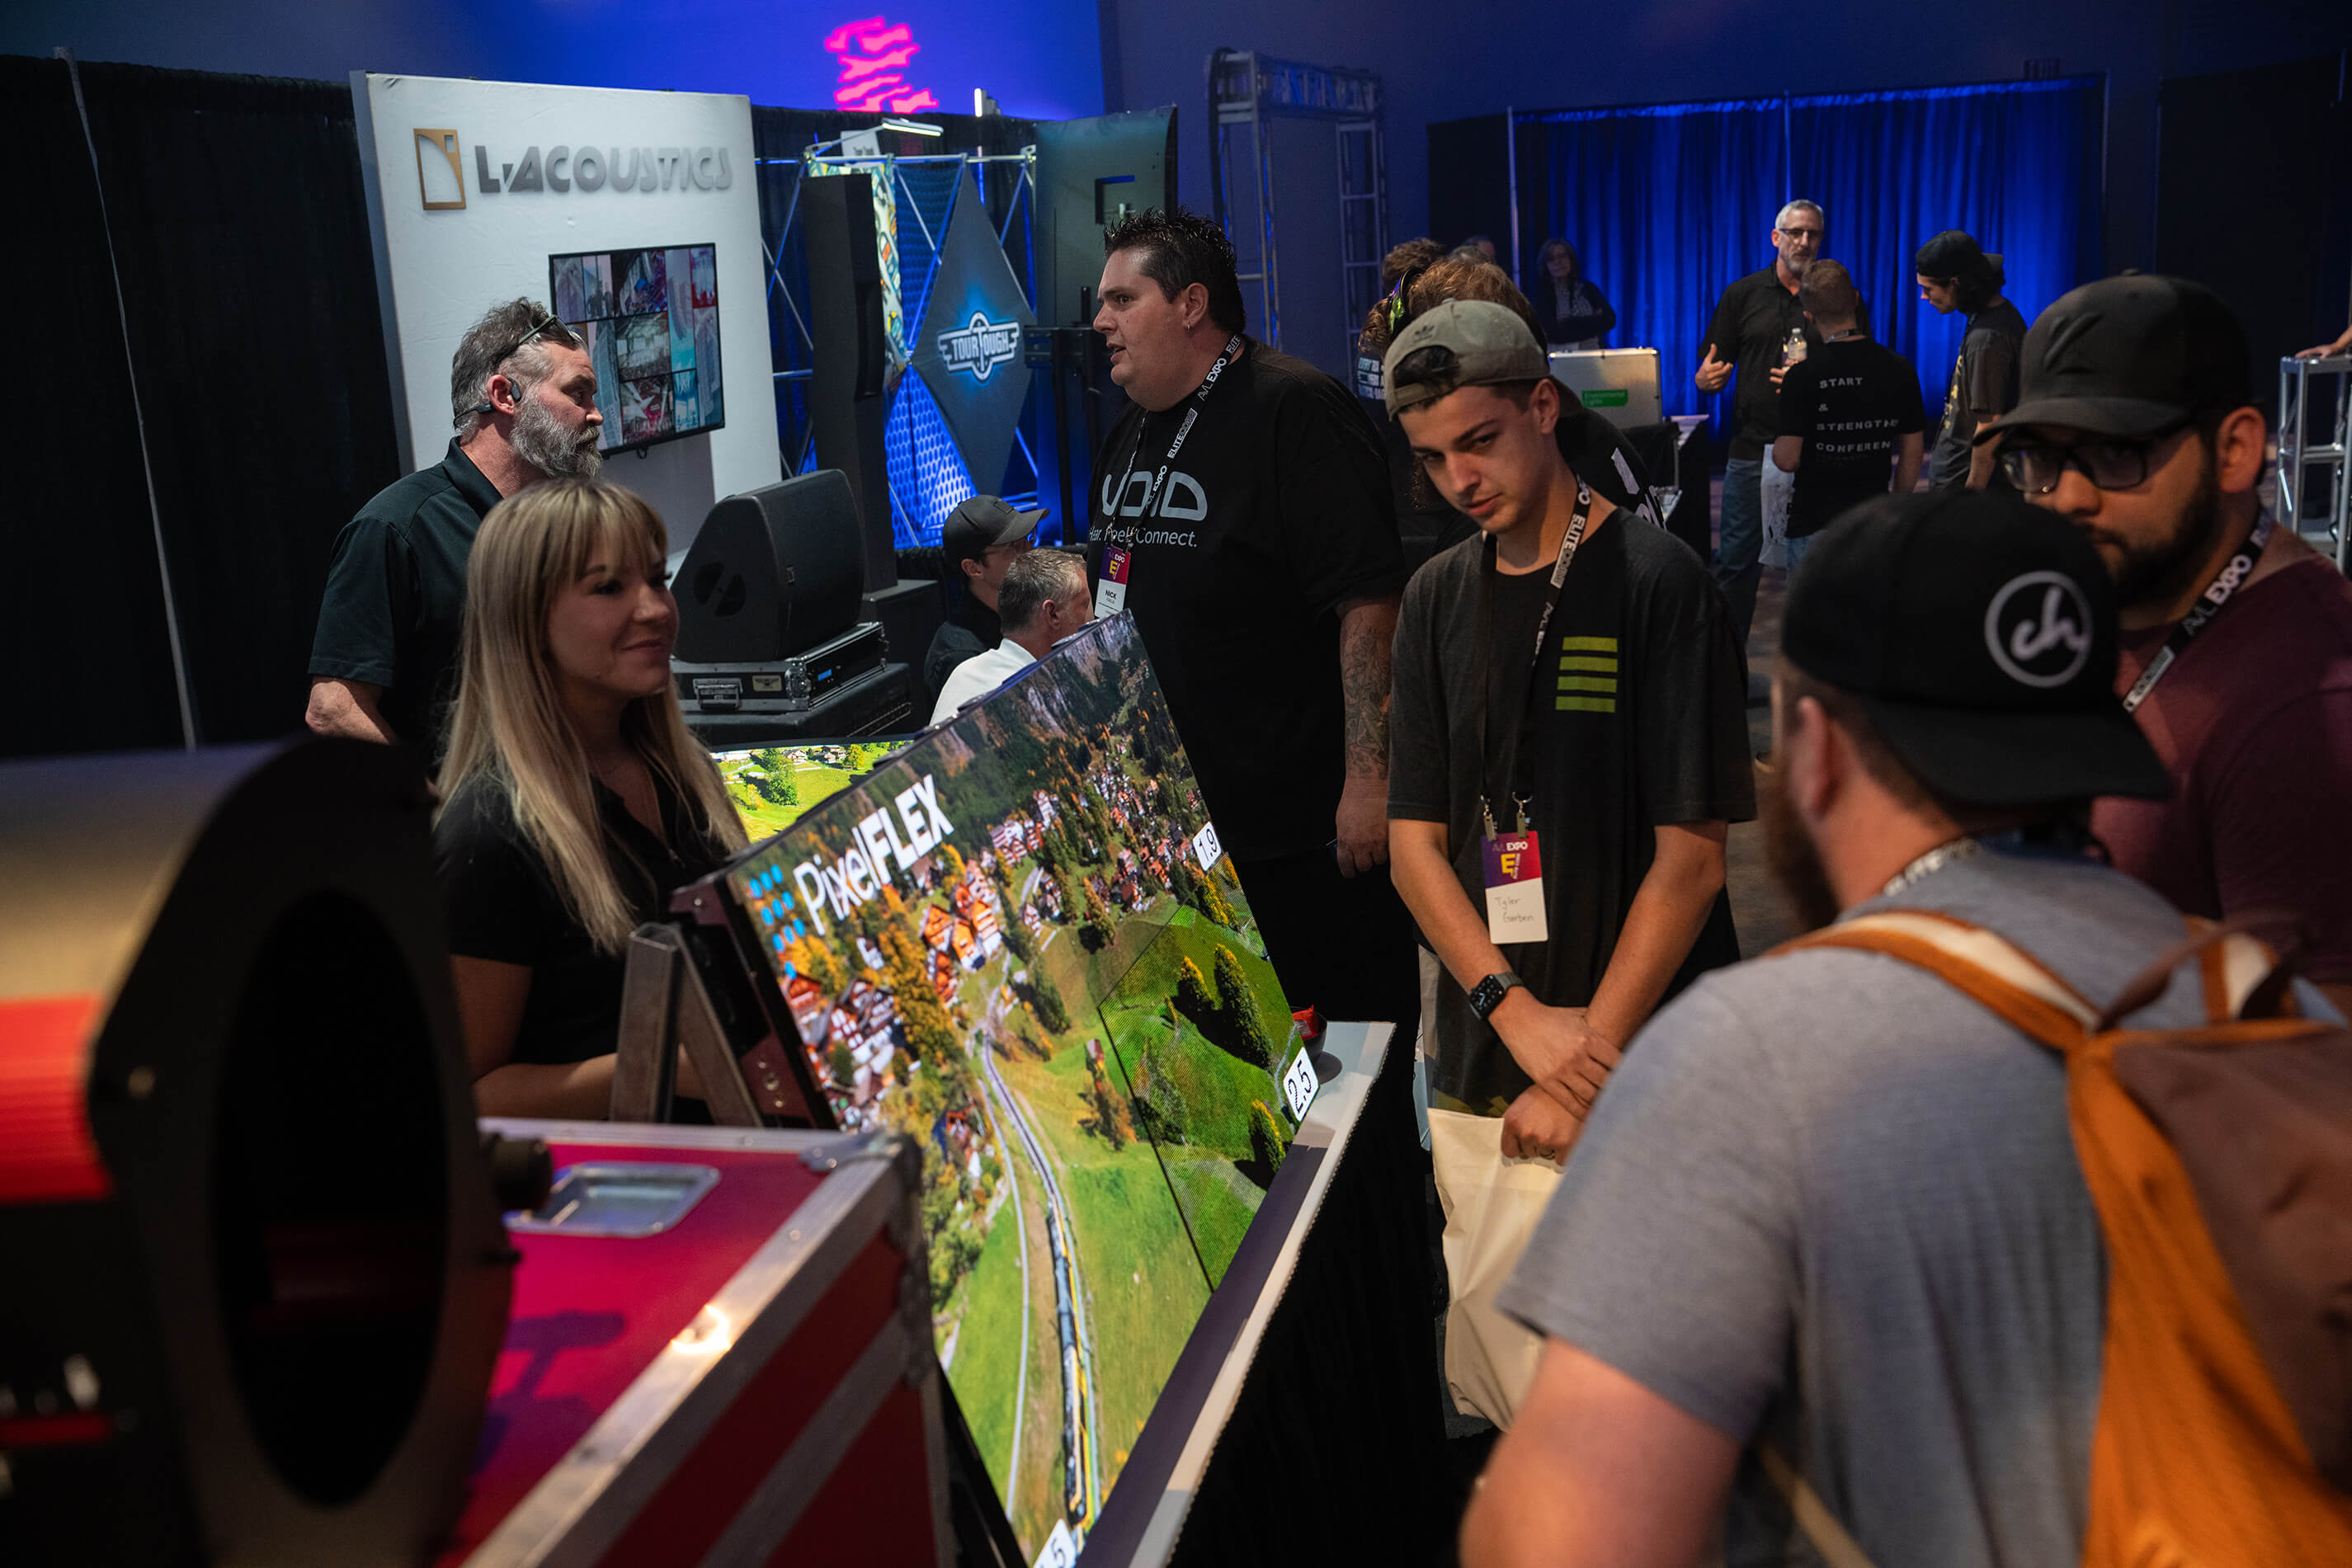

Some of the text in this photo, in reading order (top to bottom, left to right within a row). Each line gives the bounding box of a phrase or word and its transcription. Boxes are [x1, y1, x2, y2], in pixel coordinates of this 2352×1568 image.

[1197, 358, 1227, 401] AVL EXPO
[1819, 376, 1864, 389] START
[1818, 403, 1829, 412] &
[2204, 554, 2253, 605] EXPO
[792, 772, 954, 937] PixelFLEX
[1198, 827, 1218, 862] 1.9
[1506, 841, 1529, 852] EXPO
[1288, 1059, 1312, 1114] 2.5
